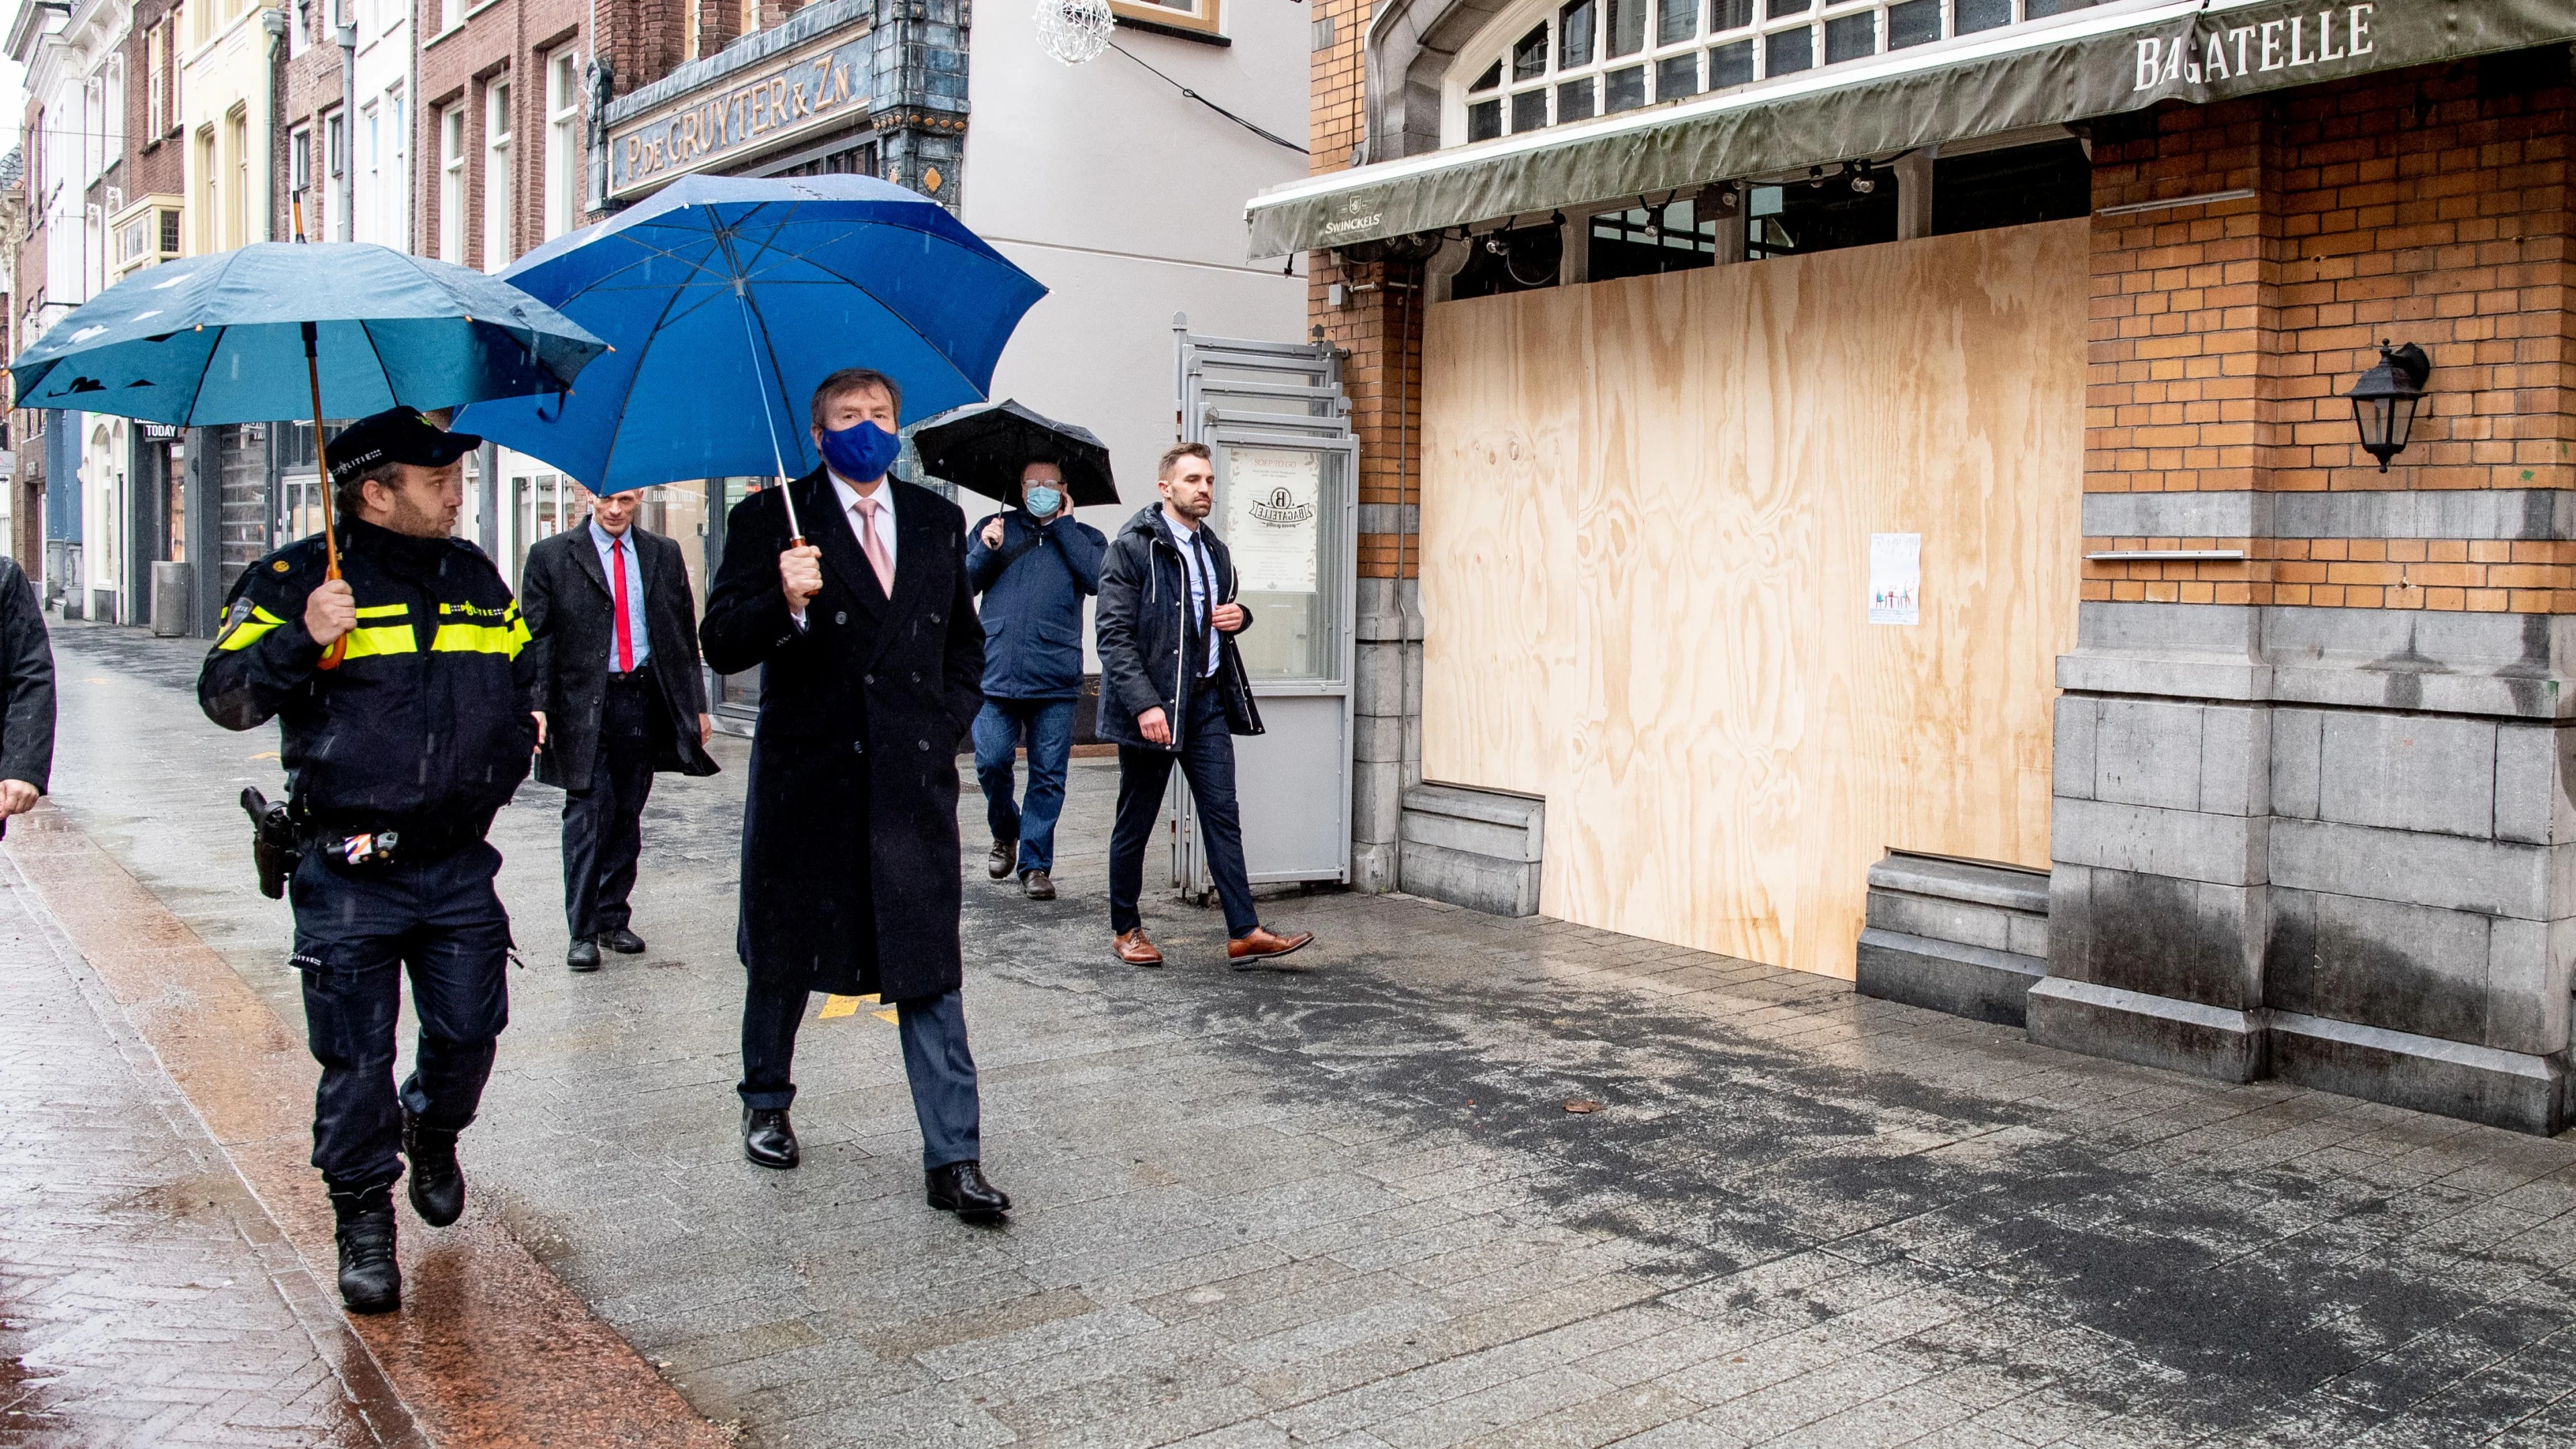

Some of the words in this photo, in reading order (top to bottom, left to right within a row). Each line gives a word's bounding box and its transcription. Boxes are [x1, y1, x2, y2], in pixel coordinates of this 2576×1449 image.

[2133, 3, 2373, 91] BAGATELLE
[667, 76, 789, 165] GRUYTER
[792, 82, 809, 119] &
[146, 425, 176, 437] TODAY
[1254, 459, 1273, 467] SOEP
[1274, 460, 1284, 468] TO
[653, 490, 669, 502] HANG
